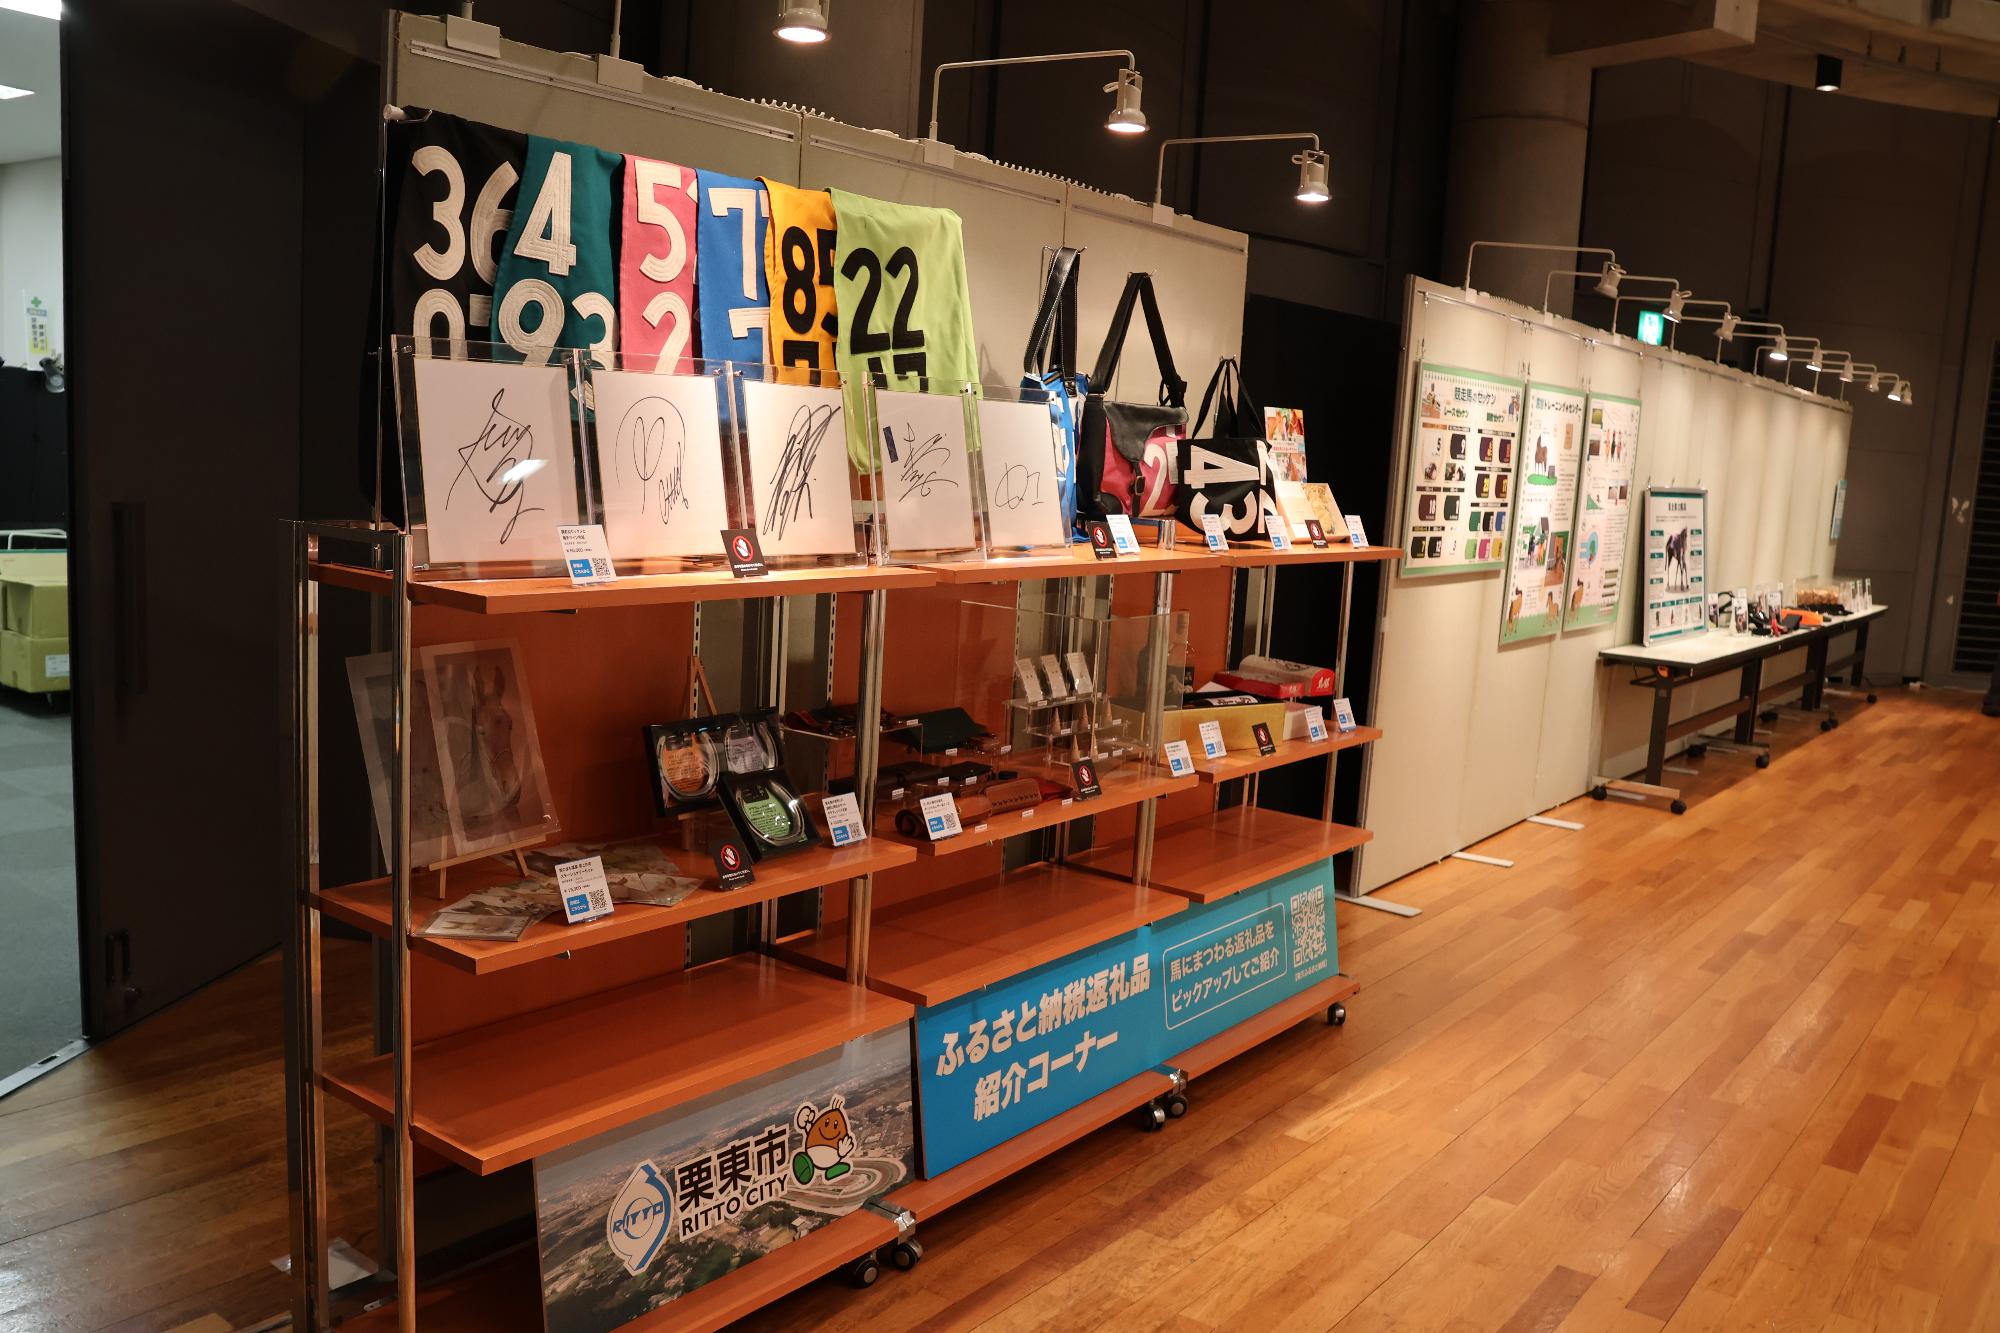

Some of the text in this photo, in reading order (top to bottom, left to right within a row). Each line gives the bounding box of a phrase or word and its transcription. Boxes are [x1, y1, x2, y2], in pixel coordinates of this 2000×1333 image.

[514, 151, 577, 276] 4
[841, 246, 925, 354] 22
[1170, 920, 1275, 982] 馬にまつわる返礼品を
[1172, 946, 1280, 1013] ピックアップしてご紹介
[935, 953, 1151, 1076] ふるさと納税返礼品
[973, 1031, 1118, 1122] 紹介コーナー
[678, 1129, 787, 1213] 栗東市
[682, 1173, 788, 1236] RITTO CITY
